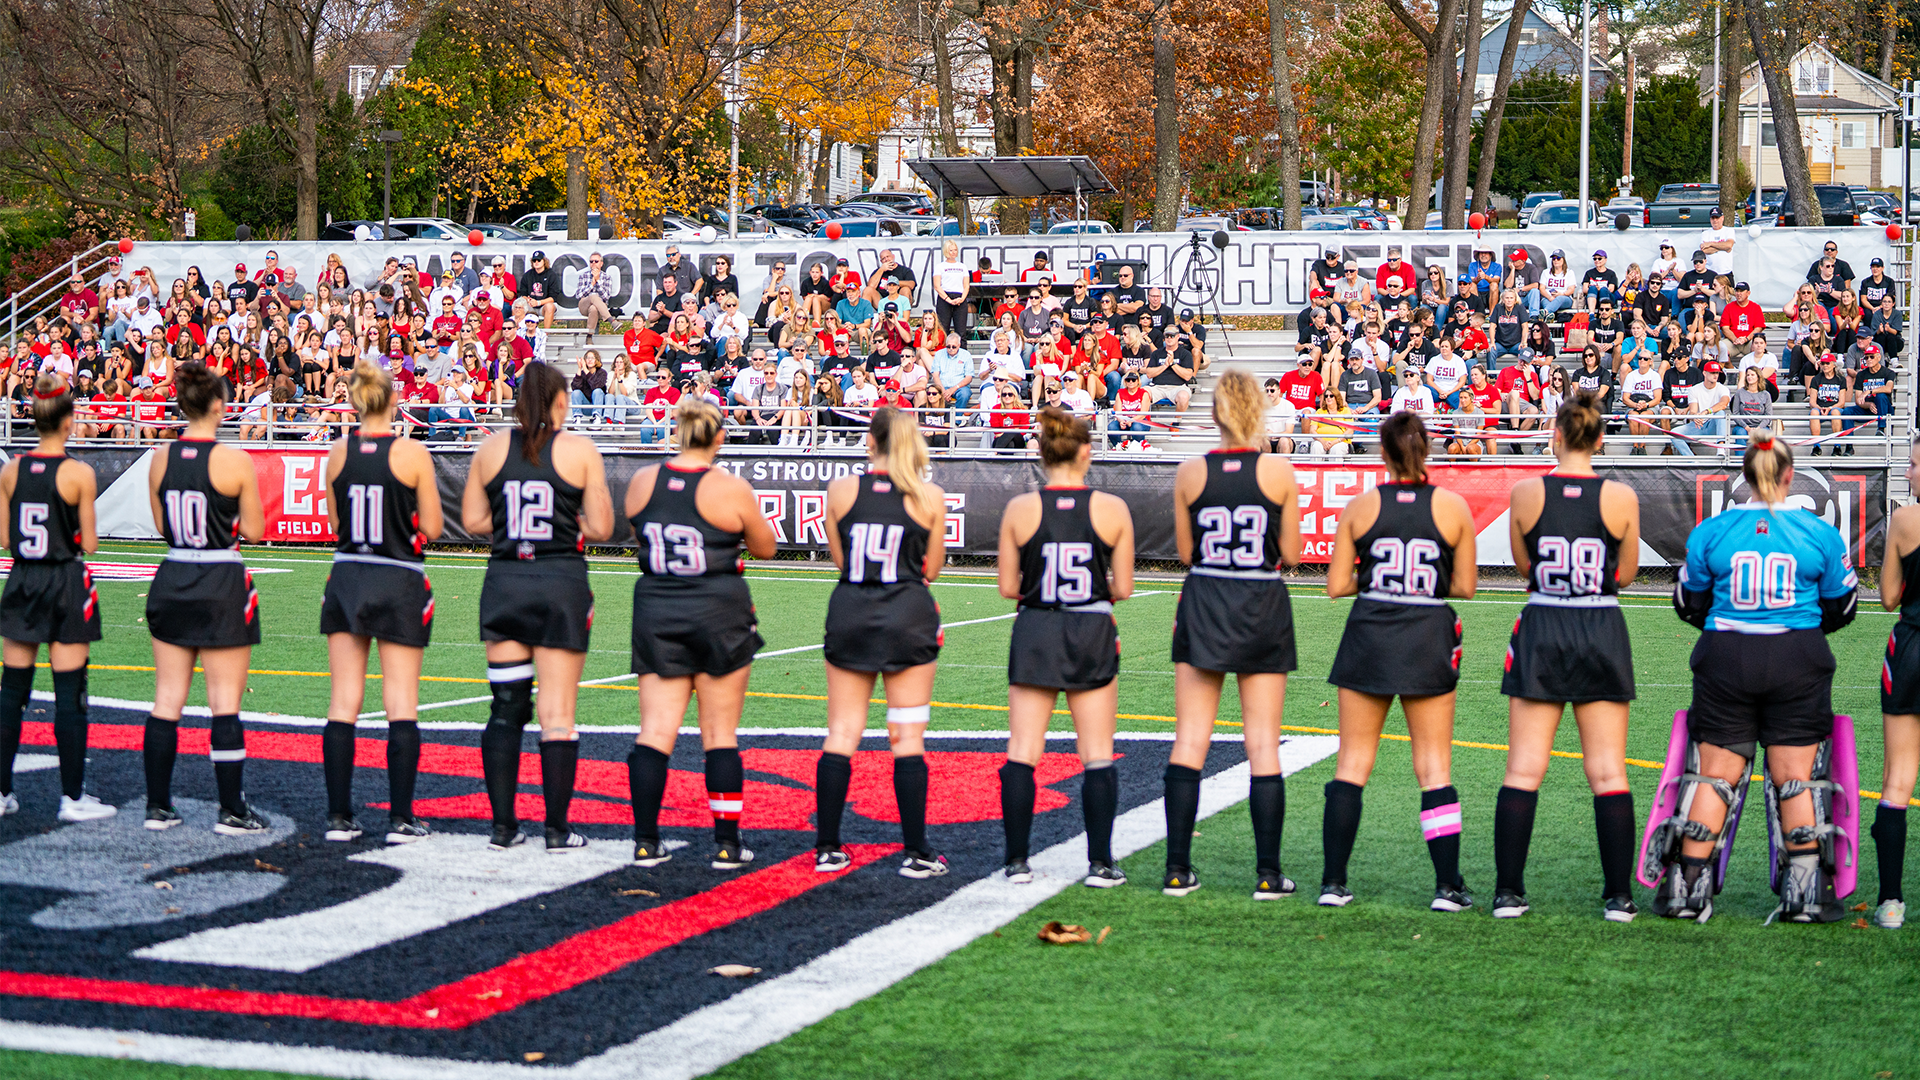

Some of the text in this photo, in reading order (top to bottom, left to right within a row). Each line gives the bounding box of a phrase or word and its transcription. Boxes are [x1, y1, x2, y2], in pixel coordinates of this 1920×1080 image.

[755, 251, 841, 308] TO
[1342, 244, 1548, 303] FED
[1548, 278, 1565, 288] ESU
[1070, 308, 1088, 318] ESU
[1409, 353, 1426, 365] ESU
[1436, 366, 1455, 377] ESU
[749, 377, 765, 385] ESU
[1292, 384, 1311, 396] ESU
[1578, 375, 1599, 387] ESU
[1635, 380, 1652, 390] ESU
[761, 395, 779, 406] ESU
[1404, 398, 1423, 410] ESU
[753, 461, 933, 483] STROUDSG
[165, 489, 208, 547] 10
[278, 521, 322, 535] FIELD
[348, 484, 384, 545] 11
[502, 480, 554, 541] 12
[19, 502, 49, 559] 5
[643, 521, 707, 576] 13
[1197, 505, 1268, 567] 23
[849, 523, 904, 583] 14
[1041, 541, 1093, 603] 15
[1369, 536, 1440, 597] 26
[1537, 536, 1606, 596] 28
[1730, 550, 1797, 611] 00
